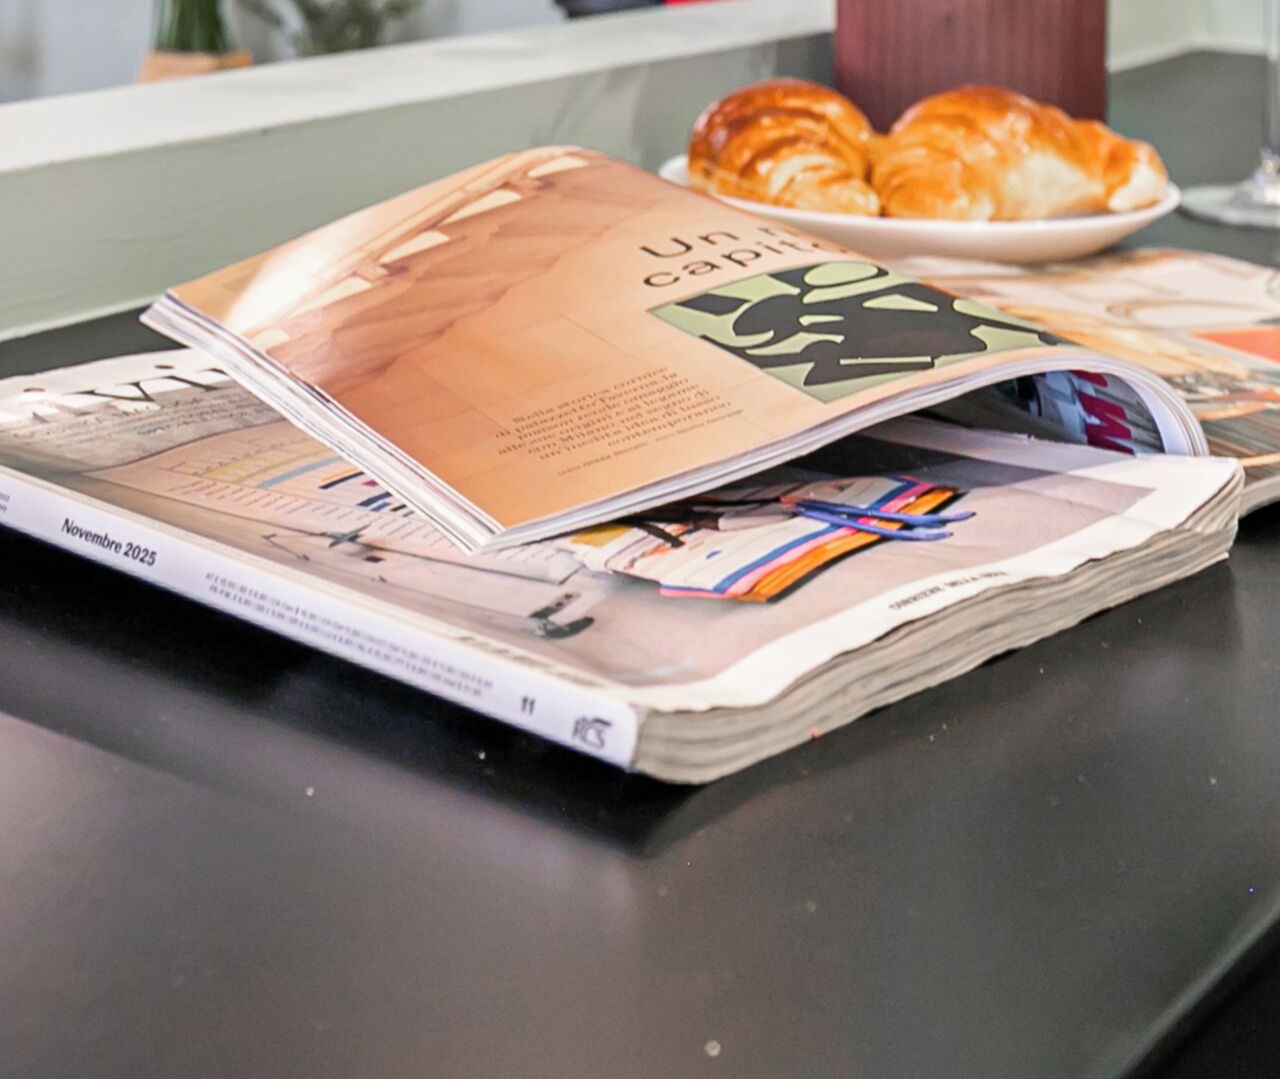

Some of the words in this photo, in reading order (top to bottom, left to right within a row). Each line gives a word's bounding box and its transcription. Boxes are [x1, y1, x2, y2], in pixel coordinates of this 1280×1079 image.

[639, 230, 740, 259] Un
[61, 517, 122, 553] Novembre
[123, 541, 158, 567] 2025
